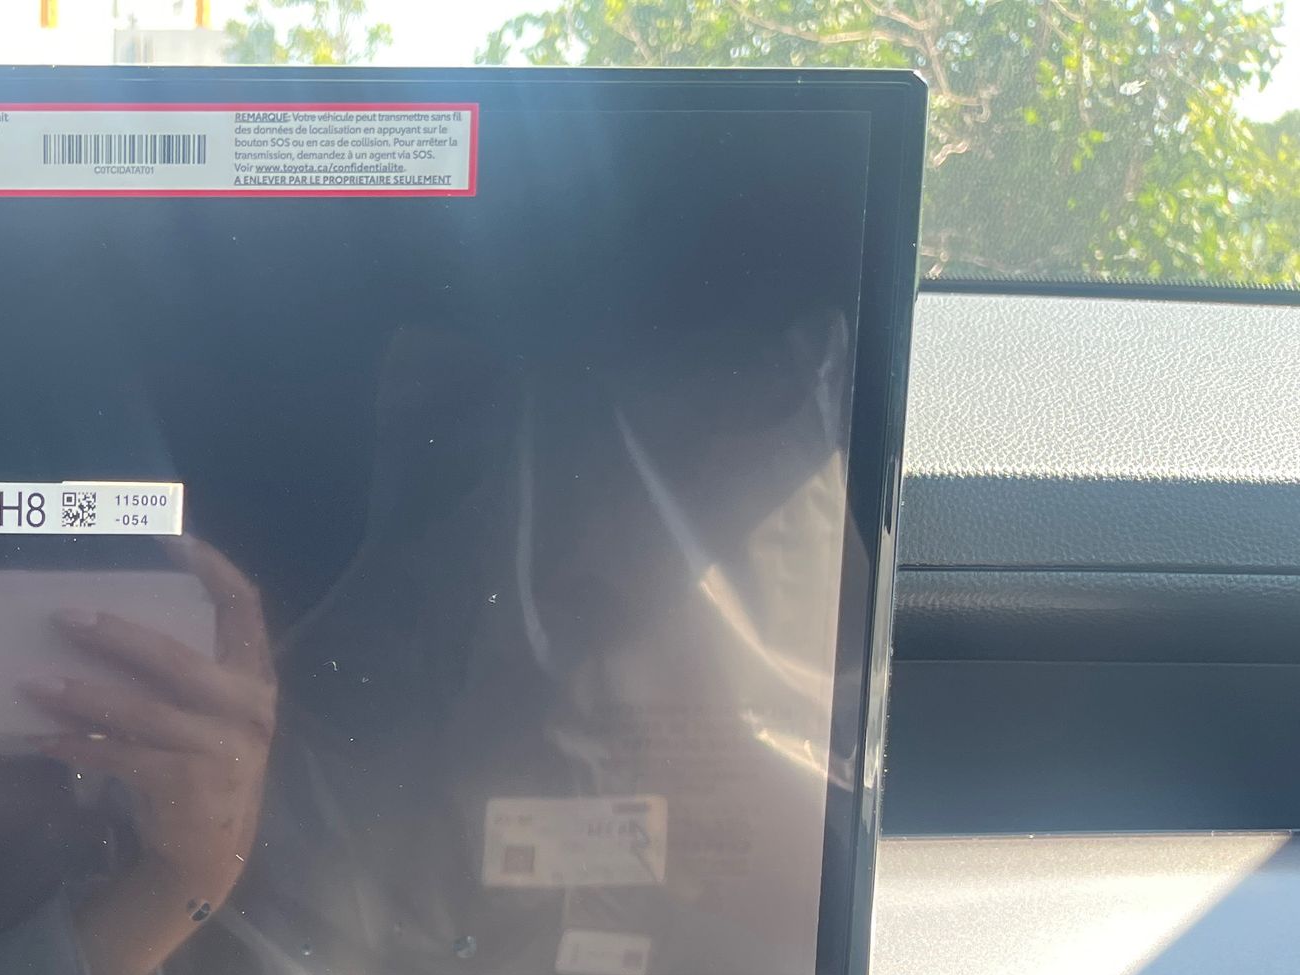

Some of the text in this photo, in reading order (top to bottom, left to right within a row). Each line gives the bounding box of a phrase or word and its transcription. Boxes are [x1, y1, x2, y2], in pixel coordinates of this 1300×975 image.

[292, 112, 317, 122] Votre
[318, 112, 354, 122] véhicule
[356, 113, 376, 123] peut
[378, 112, 430, 122] transmettre
[431, 114, 451, 122] sans
[452, 112, 462, 122] fil
[235, 125, 448, 136] des données de localisation en appuyant sur le
[235, 138, 268, 148] bouton
[270, 138, 291, 148] SOS
[292, 140, 304, 148] ou
[337, 138, 349, 147] de
[350, 138, 390, 147] collision.
[393, 138, 417, 147] Pour
[449, 138, 458, 147] la
[235, 151, 295, 161] transmission,
[297, 151, 346, 160] demandez
[355, 152, 367, 160] un
[369, 152, 396, 162] agent
[398, 151, 410, 160] via
[412, 150, 435, 160] SOS.
[234, 163, 253, 172] Voir
[244, 176, 286, 186] ENLEVER
[288, 176, 306, 186] PAR
[310, 176, 322, 186] LE
[323, 176, 391, 186] PROPRIETAIRE
[394, 176, 452, 186] SEULEMENT
[115, 494, 168, 506] 115000
[0, 491, 46, 528] H8
[115, 514, 149, 526] -054
